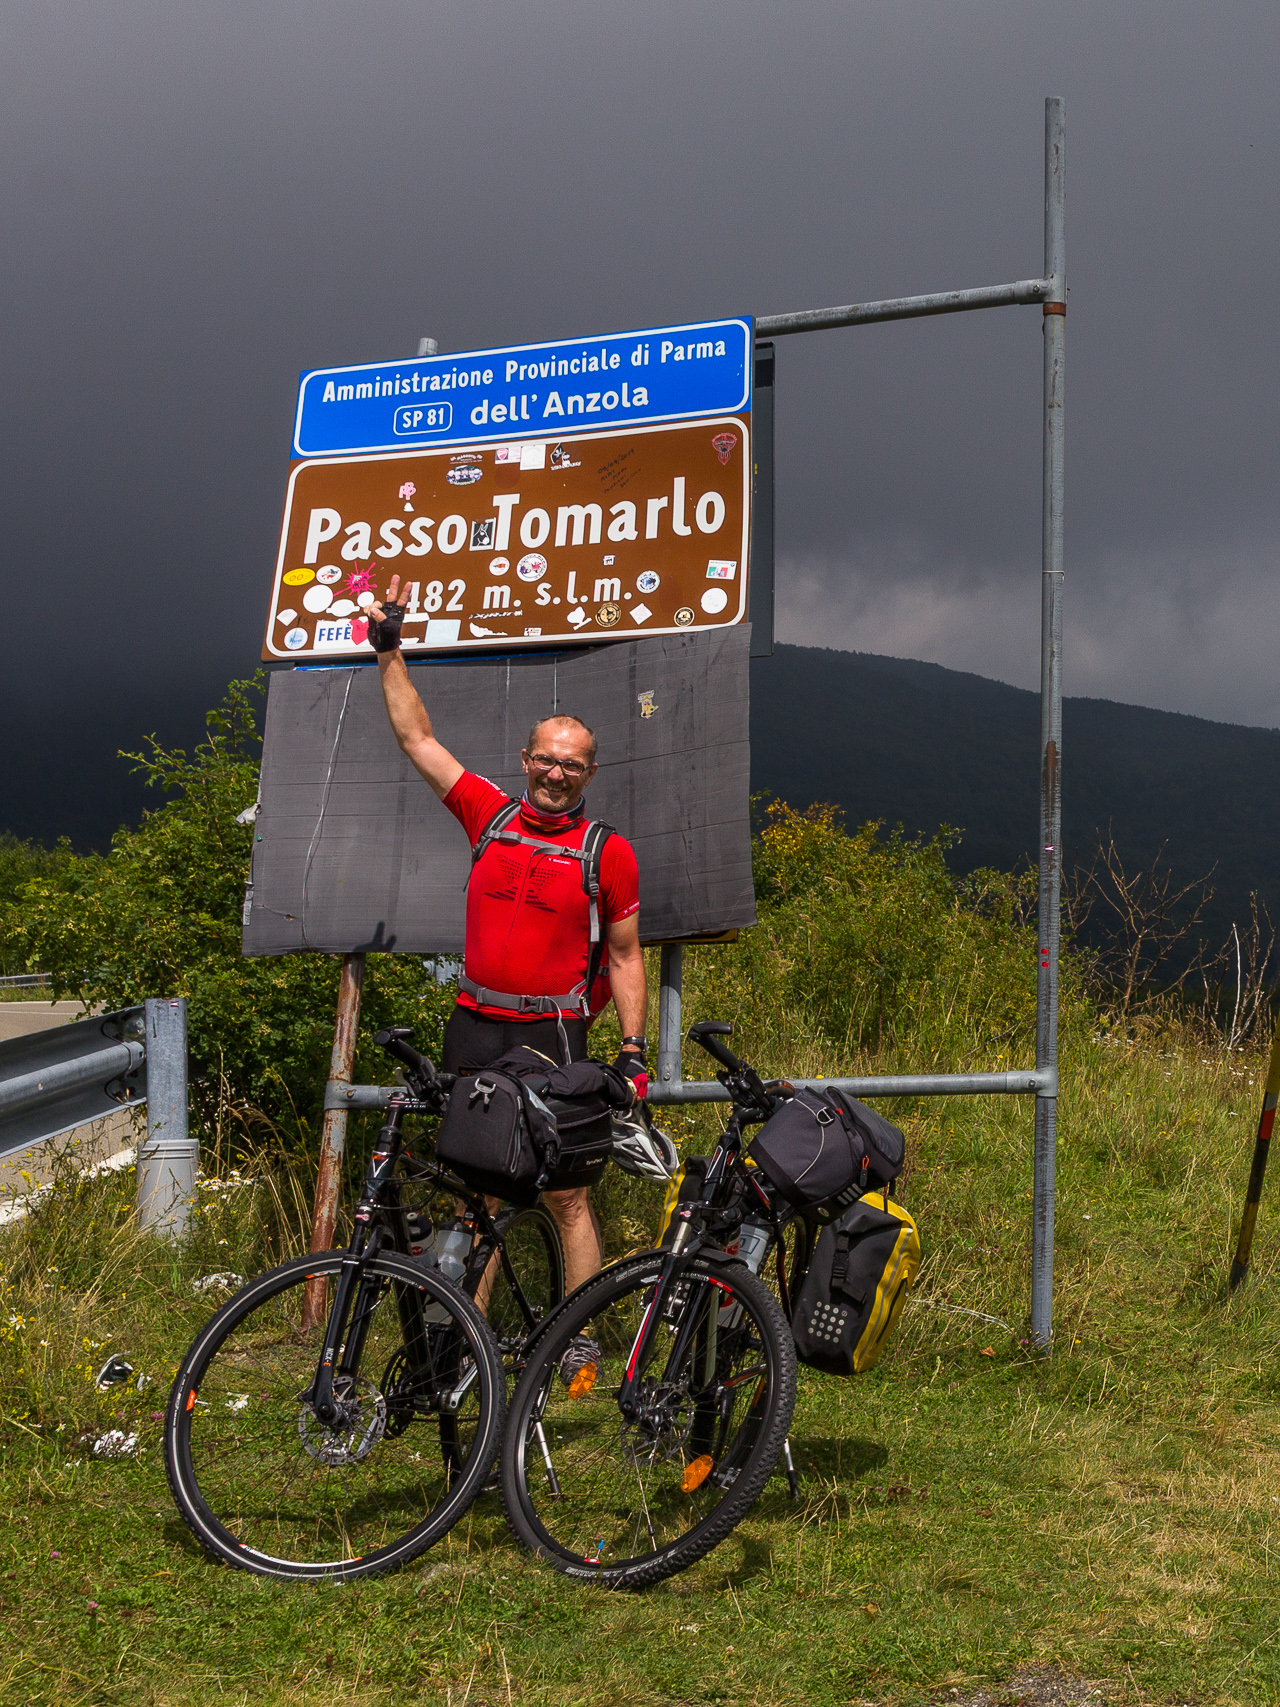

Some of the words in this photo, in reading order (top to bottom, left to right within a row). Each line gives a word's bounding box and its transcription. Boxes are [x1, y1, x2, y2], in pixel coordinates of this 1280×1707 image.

[322, 368, 494, 403] Amministrazione
[505, 347, 621, 383] Provinciale
[630, 342, 651, 368] di
[660, 339, 726, 364] Parma
[402, 411, 424, 429] SP
[427, 407, 445, 426] 81
[303, 507, 469, 566] Passo
[492, 476, 727, 553] Tomarlo
[386, 578, 468, 614] 482
[482, 584, 529, 611] m.
[534, 570, 632, 606] s.l.m.
[318, 623, 352, 642] FEFÈ
